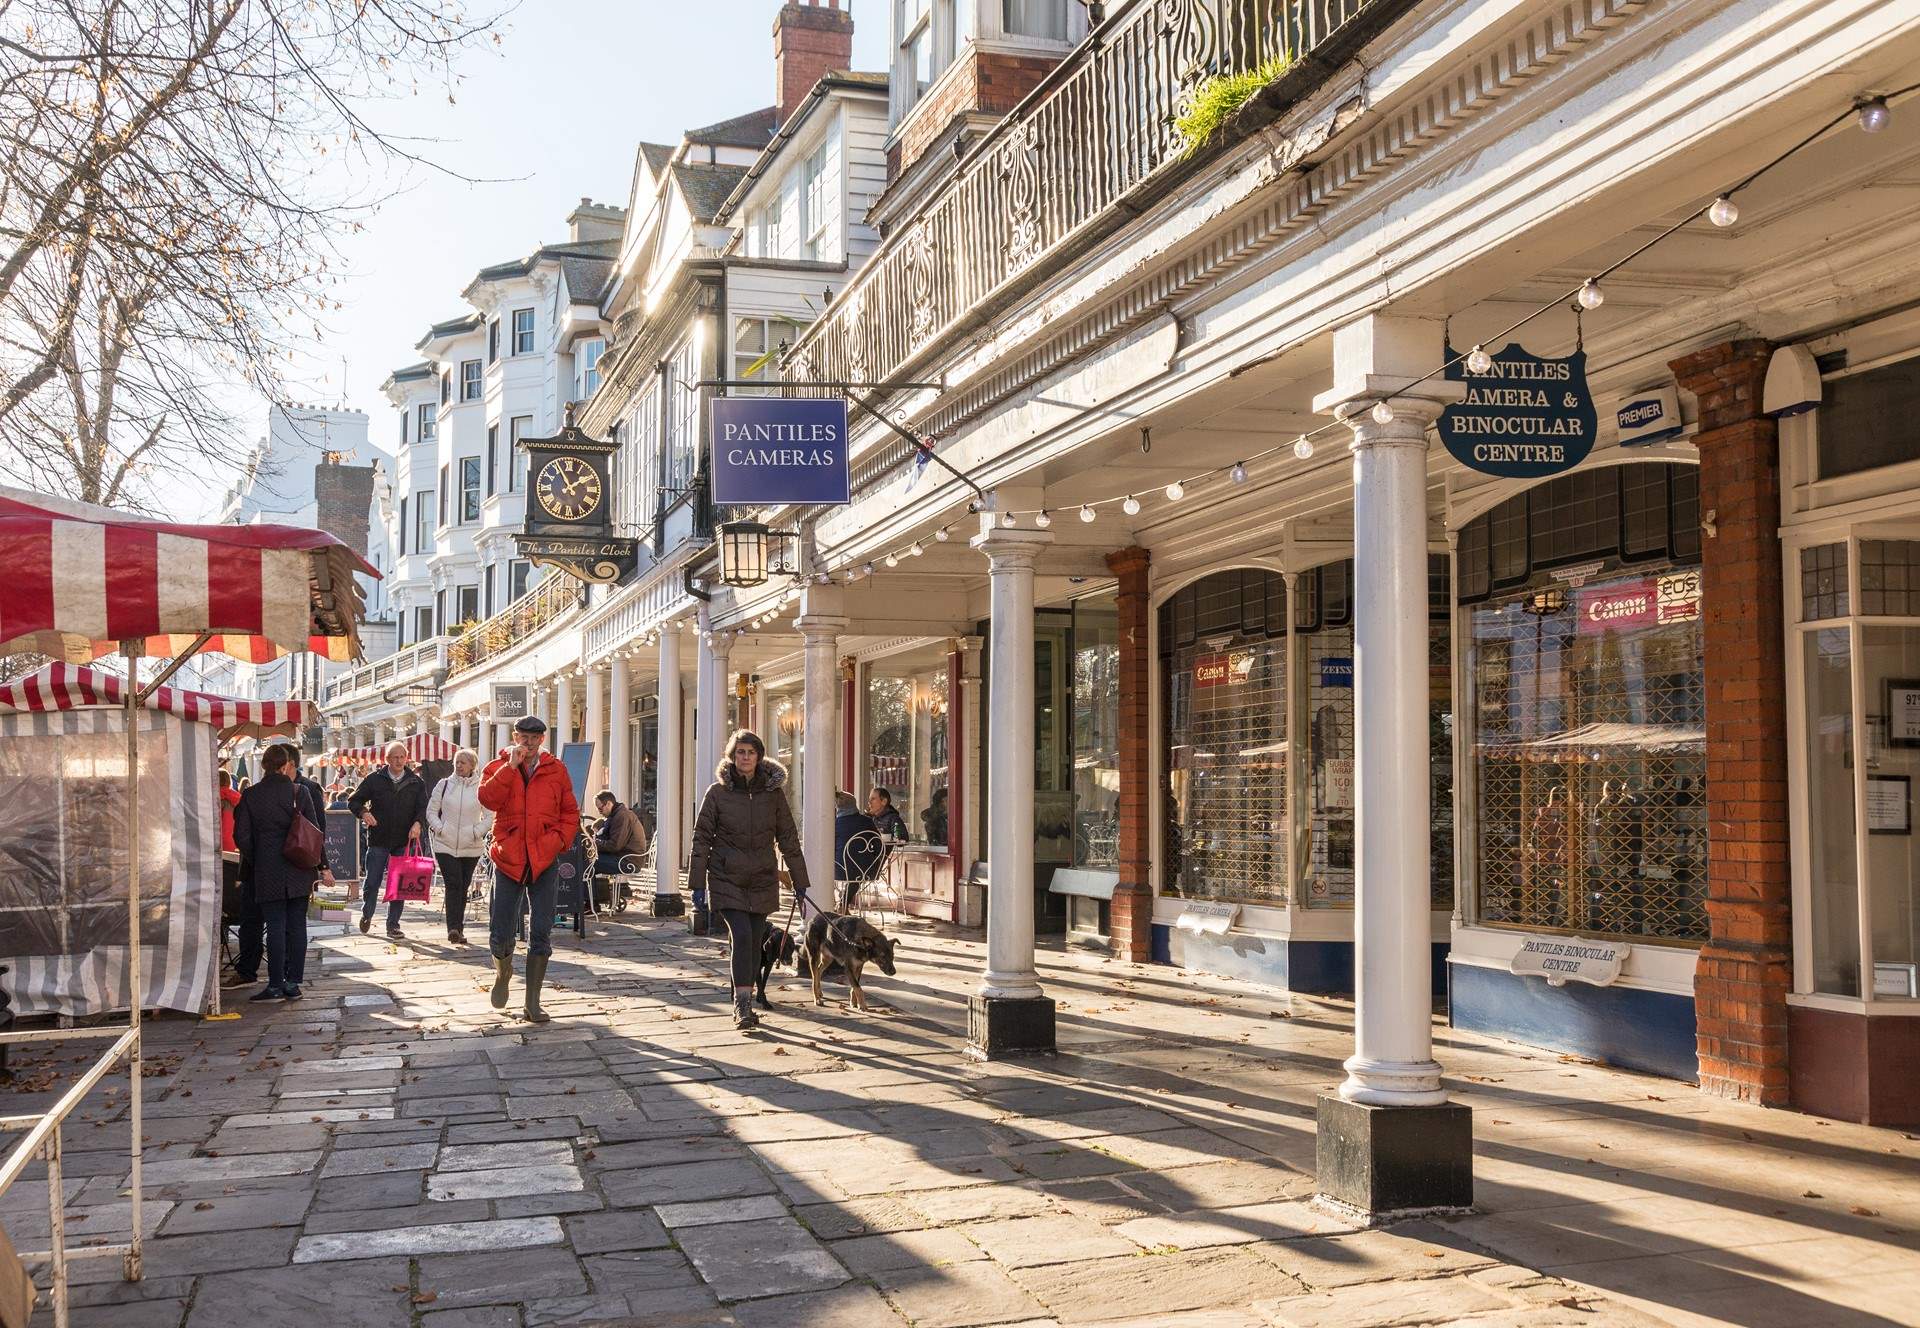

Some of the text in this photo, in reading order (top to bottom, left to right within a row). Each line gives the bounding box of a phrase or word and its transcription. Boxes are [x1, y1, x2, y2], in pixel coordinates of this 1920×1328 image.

[1461, 361, 1570, 381] PNTILES
[1456, 388, 1578, 408] AMERA &
[1619, 403, 1662, 426] PREMIER
[723, 423, 836, 441] PANTILES
[1451, 416, 1583, 436] BINOCULAR
[728, 449, 833, 466] CAMERAS
[1473, 444, 1564, 463] CENTRE
[519, 541, 631, 557] The Pantiles Clock
[1662, 576, 1697, 596] EOS
[1589, 595, 1648, 622] Canon
[1197, 666, 1224, 681] Canon
[1322, 665, 1352, 675] ZEISS
[498, 701, 522, 709] CAKE
[397, 875, 427, 893] L&S
[1523, 941, 1616, 961] PANTILES BINOCULAR
[1542, 958, 1581, 973] CENTRE
